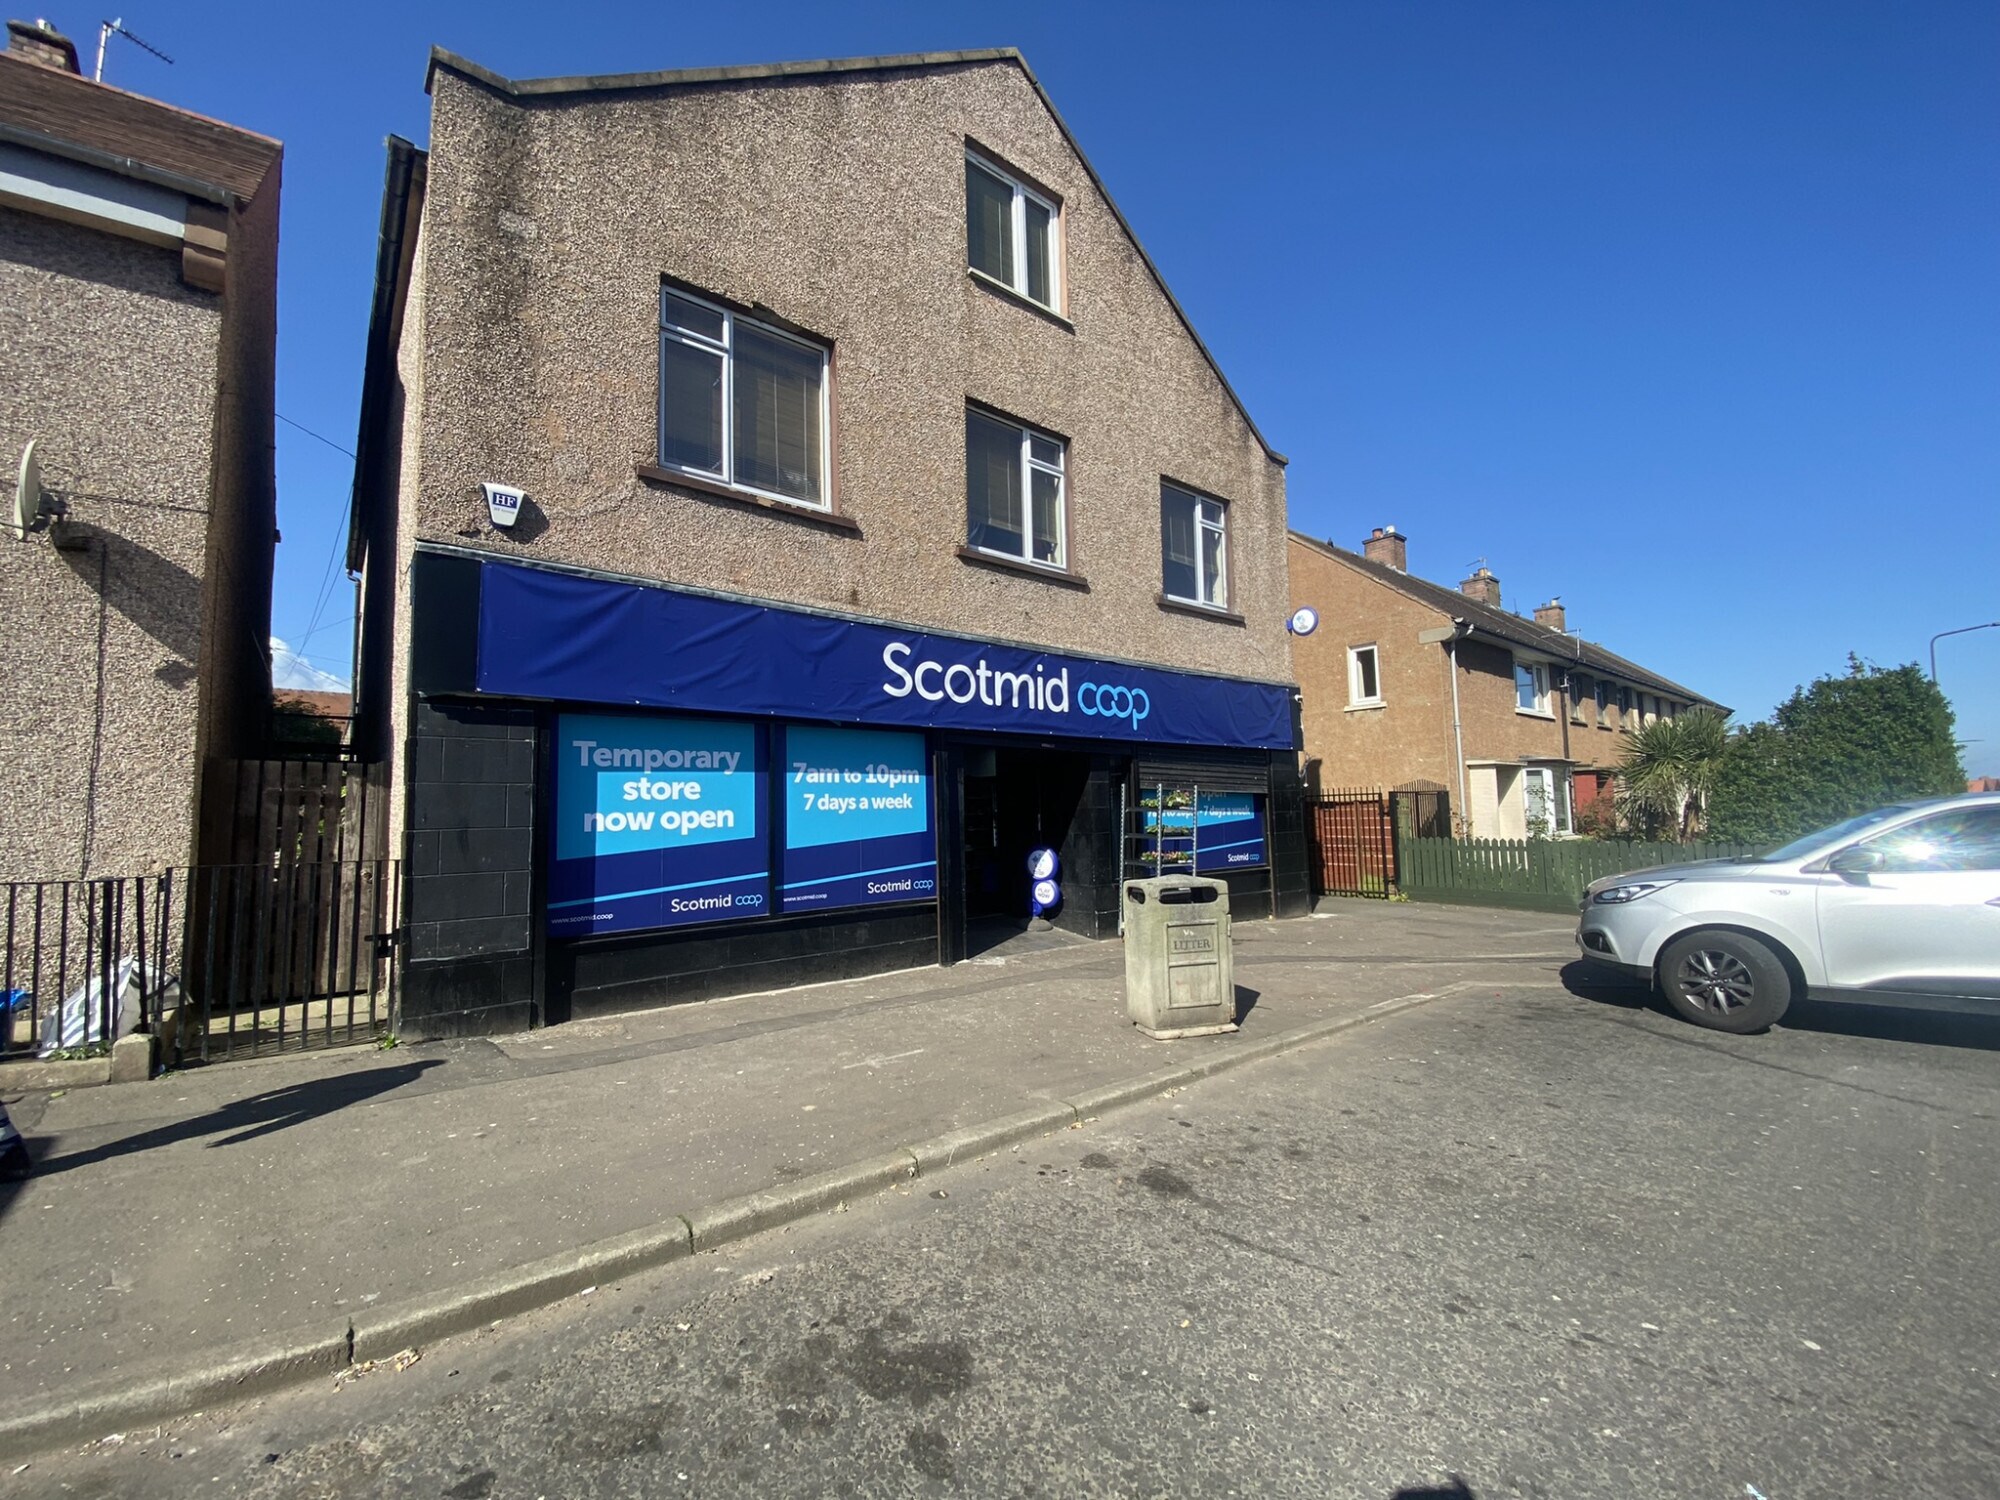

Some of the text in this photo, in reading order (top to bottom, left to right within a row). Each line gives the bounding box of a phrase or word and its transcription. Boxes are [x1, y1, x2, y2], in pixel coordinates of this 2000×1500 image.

[495, 494, 516, 507] HF
[882, 642, 1150, 731] Scotmid coop
[572, 740, 741, 775] Temporary
[793, 762, 920, 788] 7am to 10pm
[623, 777, 701, 801] store
[803, 793, 913, 815] 7 days a week
[1203, 805, 1209, 816] 7
[1209, 805, 1226, 819] days
[1231, 804, 1251, 816] week
[584, 810, 735, 836] now open
[1227, 852, 1249, 862] Scotmid
[867, 879, 934, 894] Scotmid coop
[671, 894, 763, 912] Scotmid coop
[1174, 939, 1211, 950] LITTER
